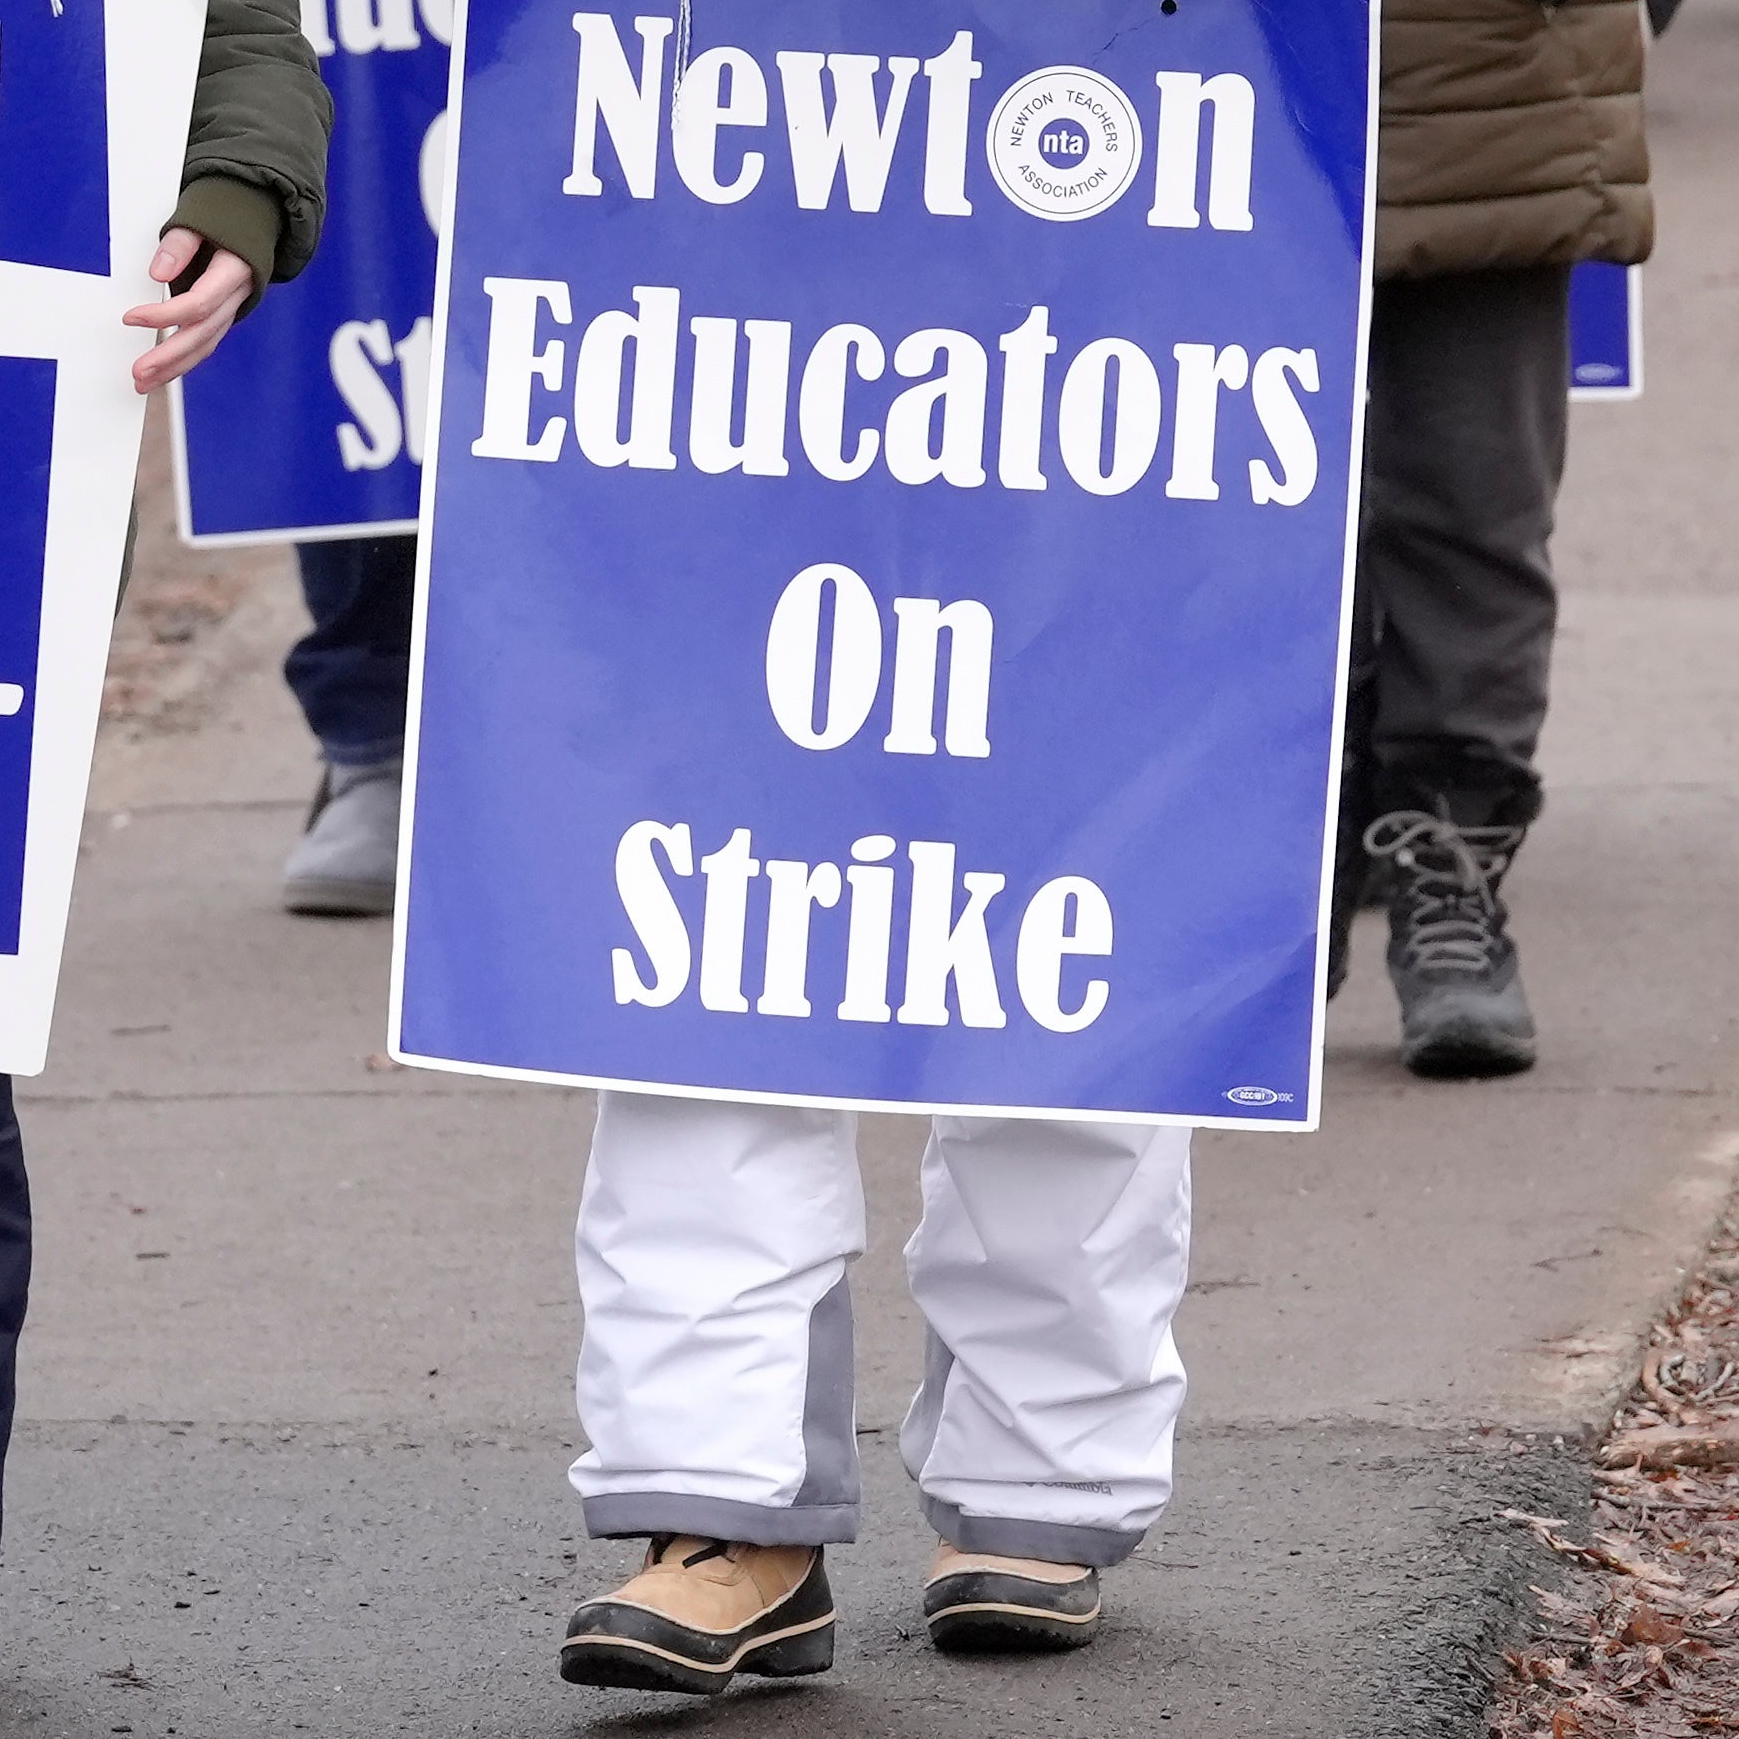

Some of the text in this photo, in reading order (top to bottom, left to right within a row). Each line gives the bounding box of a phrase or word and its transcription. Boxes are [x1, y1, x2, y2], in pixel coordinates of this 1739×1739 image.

[1010, 89, 1119, 153] NEWTON TEACHERS
[1018, 163, 1109, 199] ASSOCIATION
[1043, 129, 1084, 155] nta
[470, 276, 1321, 508] Educators
[765, 562, 994, 759] On
[611, 819, 1115, 1033] Strike
